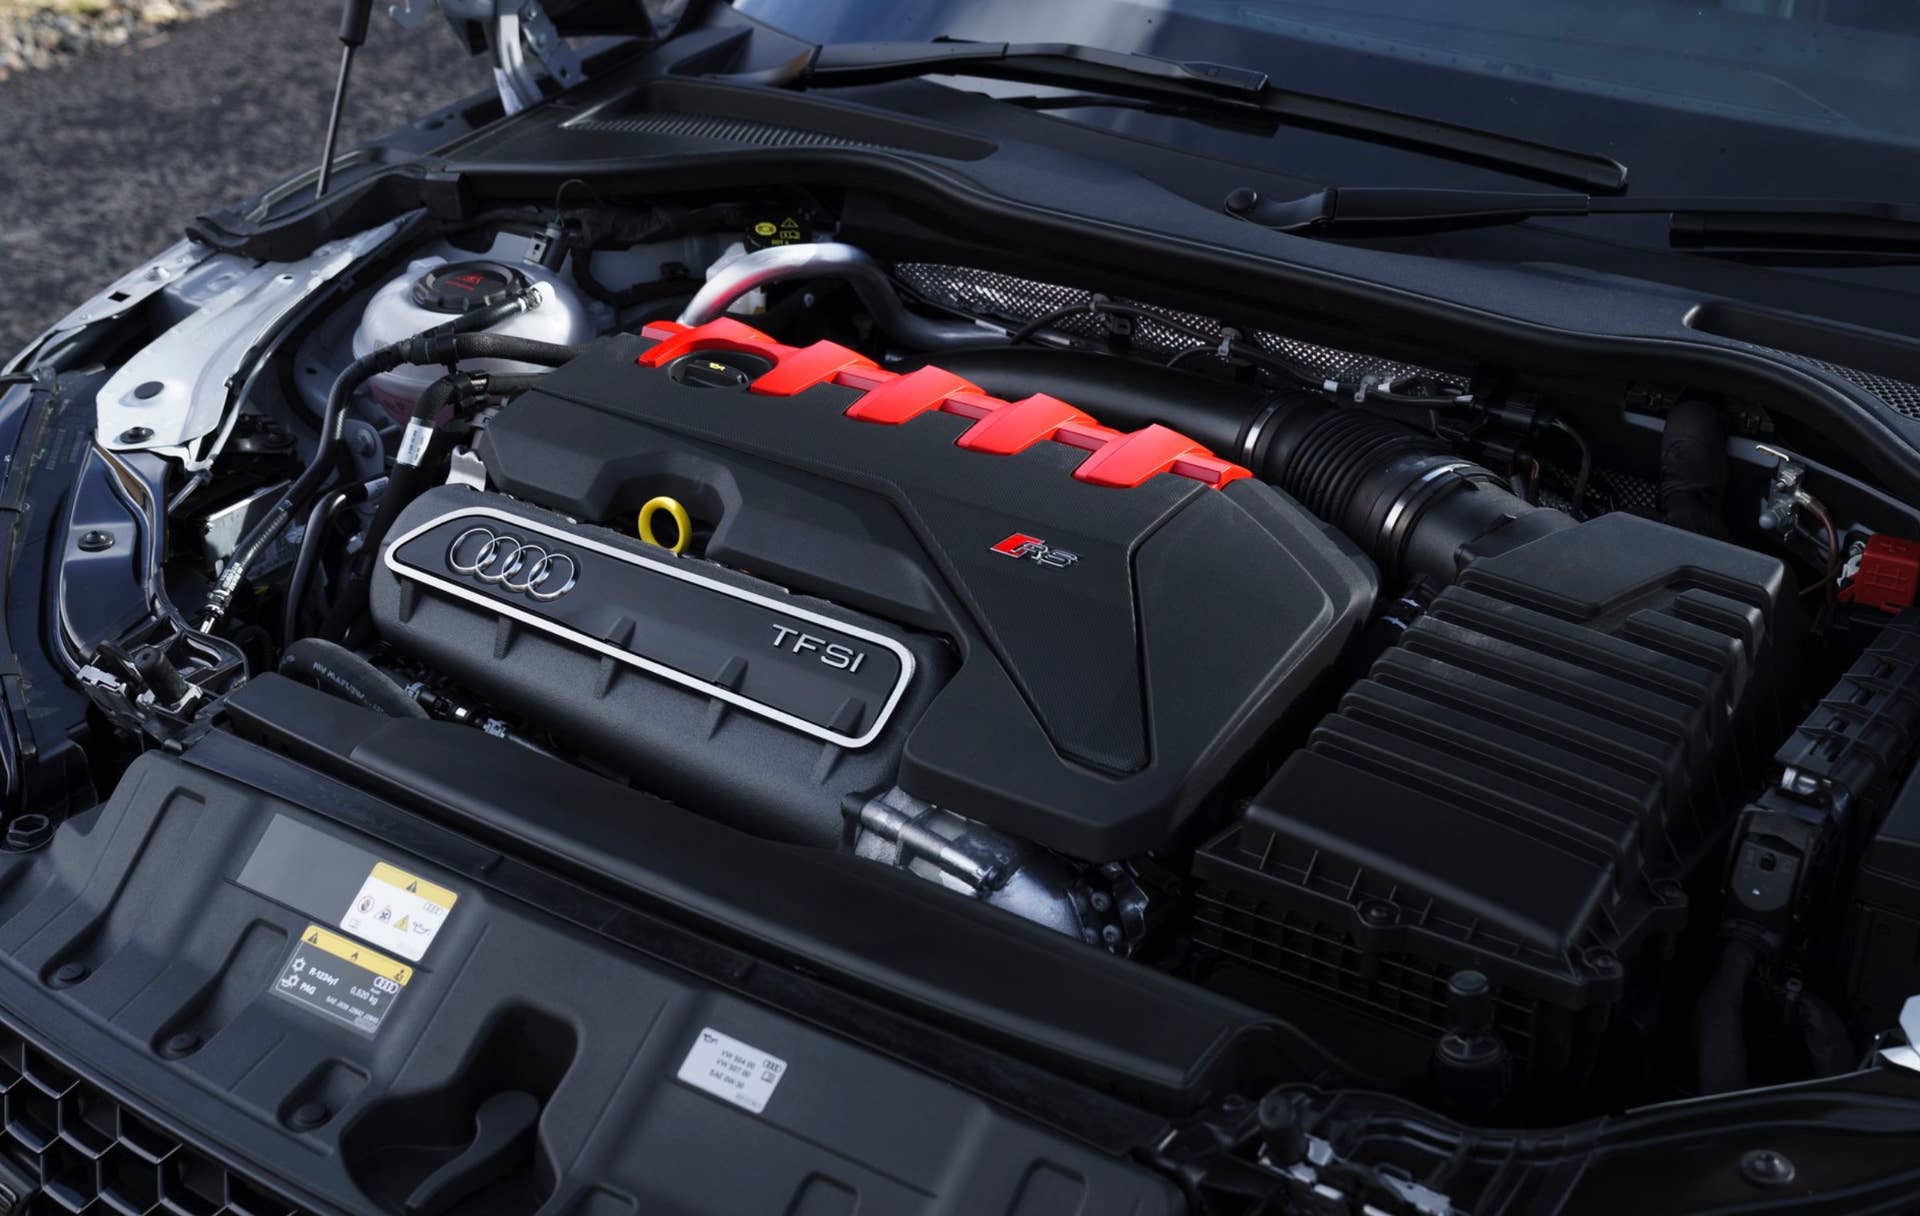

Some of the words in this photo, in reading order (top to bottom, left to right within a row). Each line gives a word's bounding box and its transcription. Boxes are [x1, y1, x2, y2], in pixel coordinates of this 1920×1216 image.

[990, 532, 1079, 568] RS
[772, 624, 864, 673] TFSI
[308, 967, 340, 986] R-1234yf
[300, 982, 317, 995] PAG
[369, 994, 379, 1005] kg
